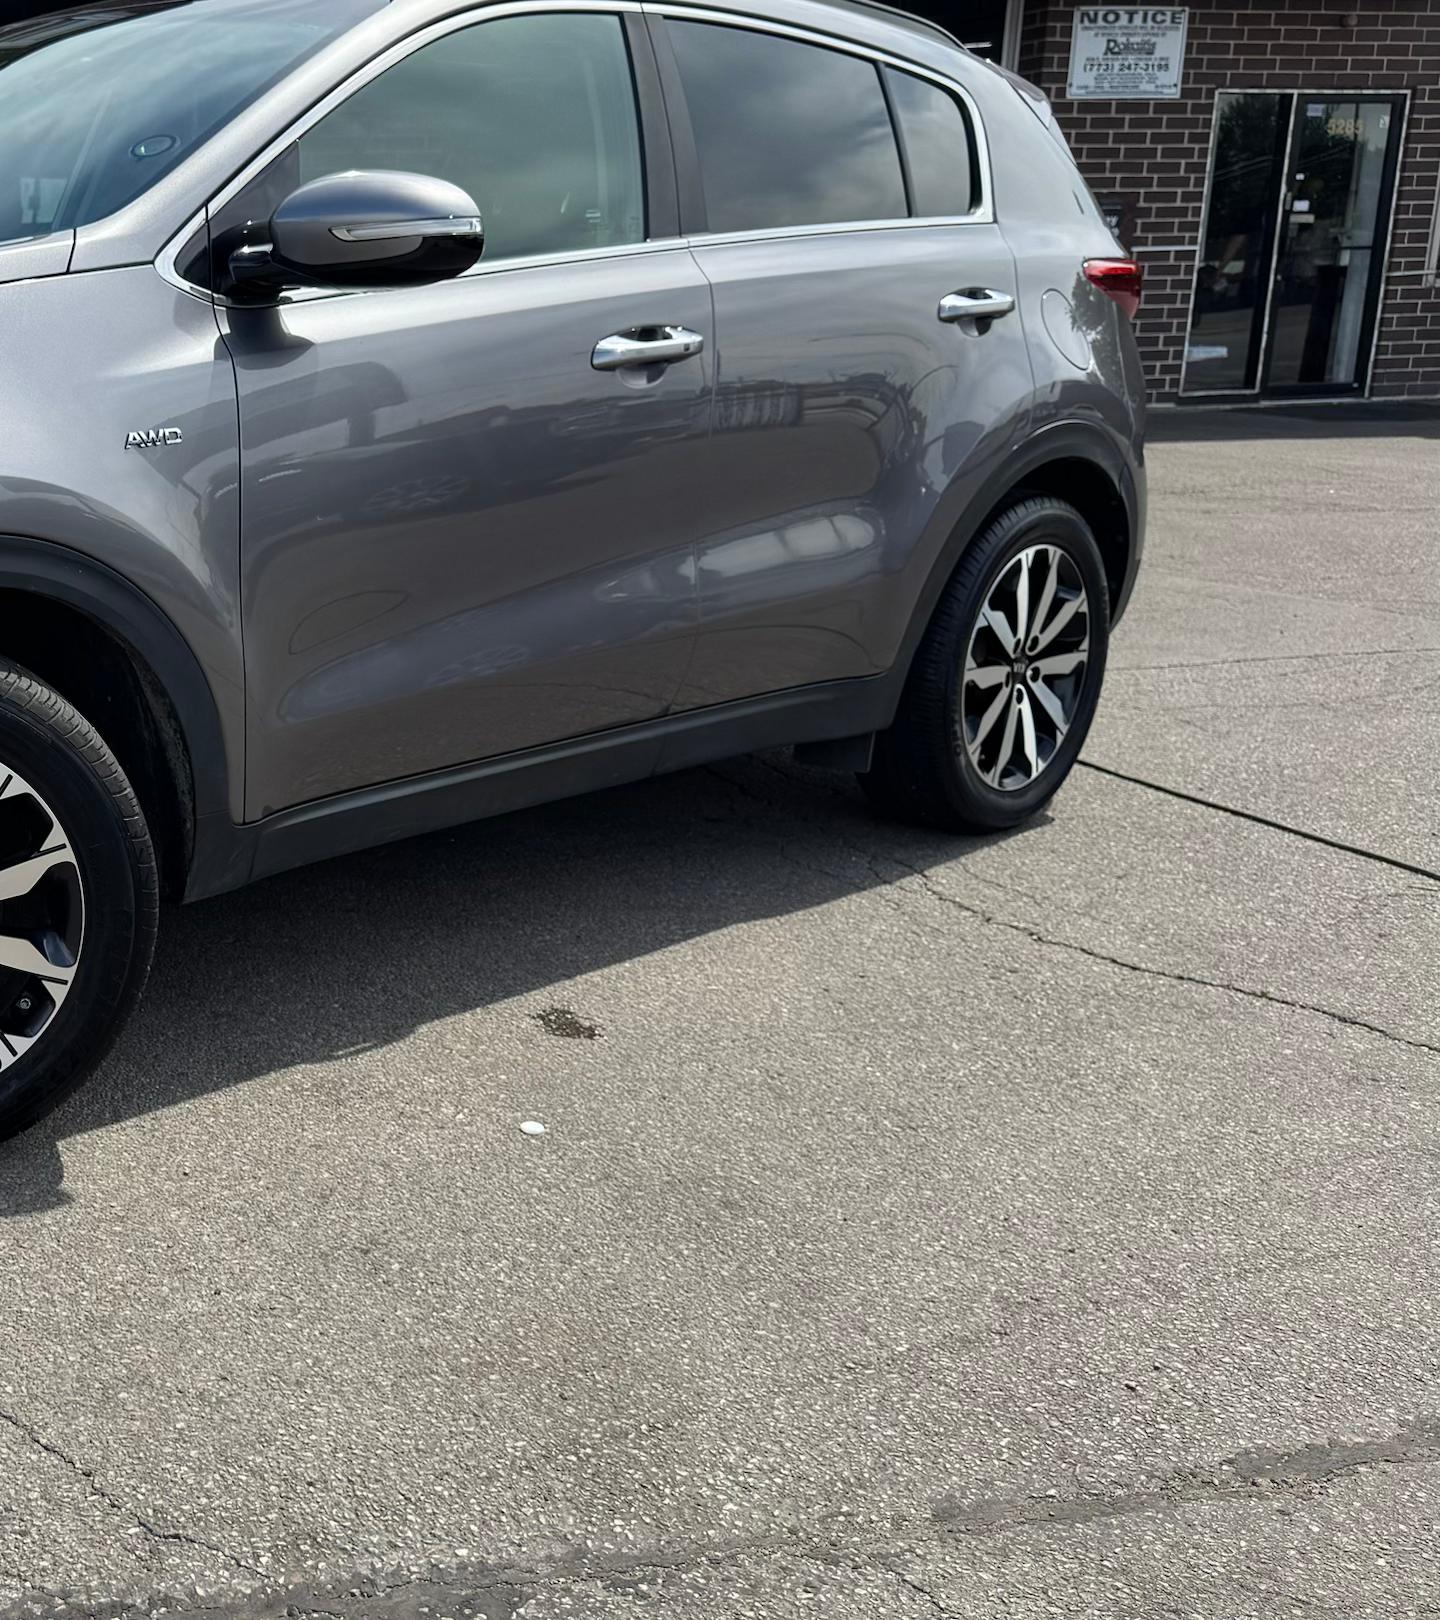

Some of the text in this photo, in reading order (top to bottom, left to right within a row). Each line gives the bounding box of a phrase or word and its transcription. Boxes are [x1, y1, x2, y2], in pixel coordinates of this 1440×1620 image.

[1079, 9, 1183, 25] NOTICE
[1083, 63, 1114, 73] (773)
[124, 427, 183, 450] AWD
